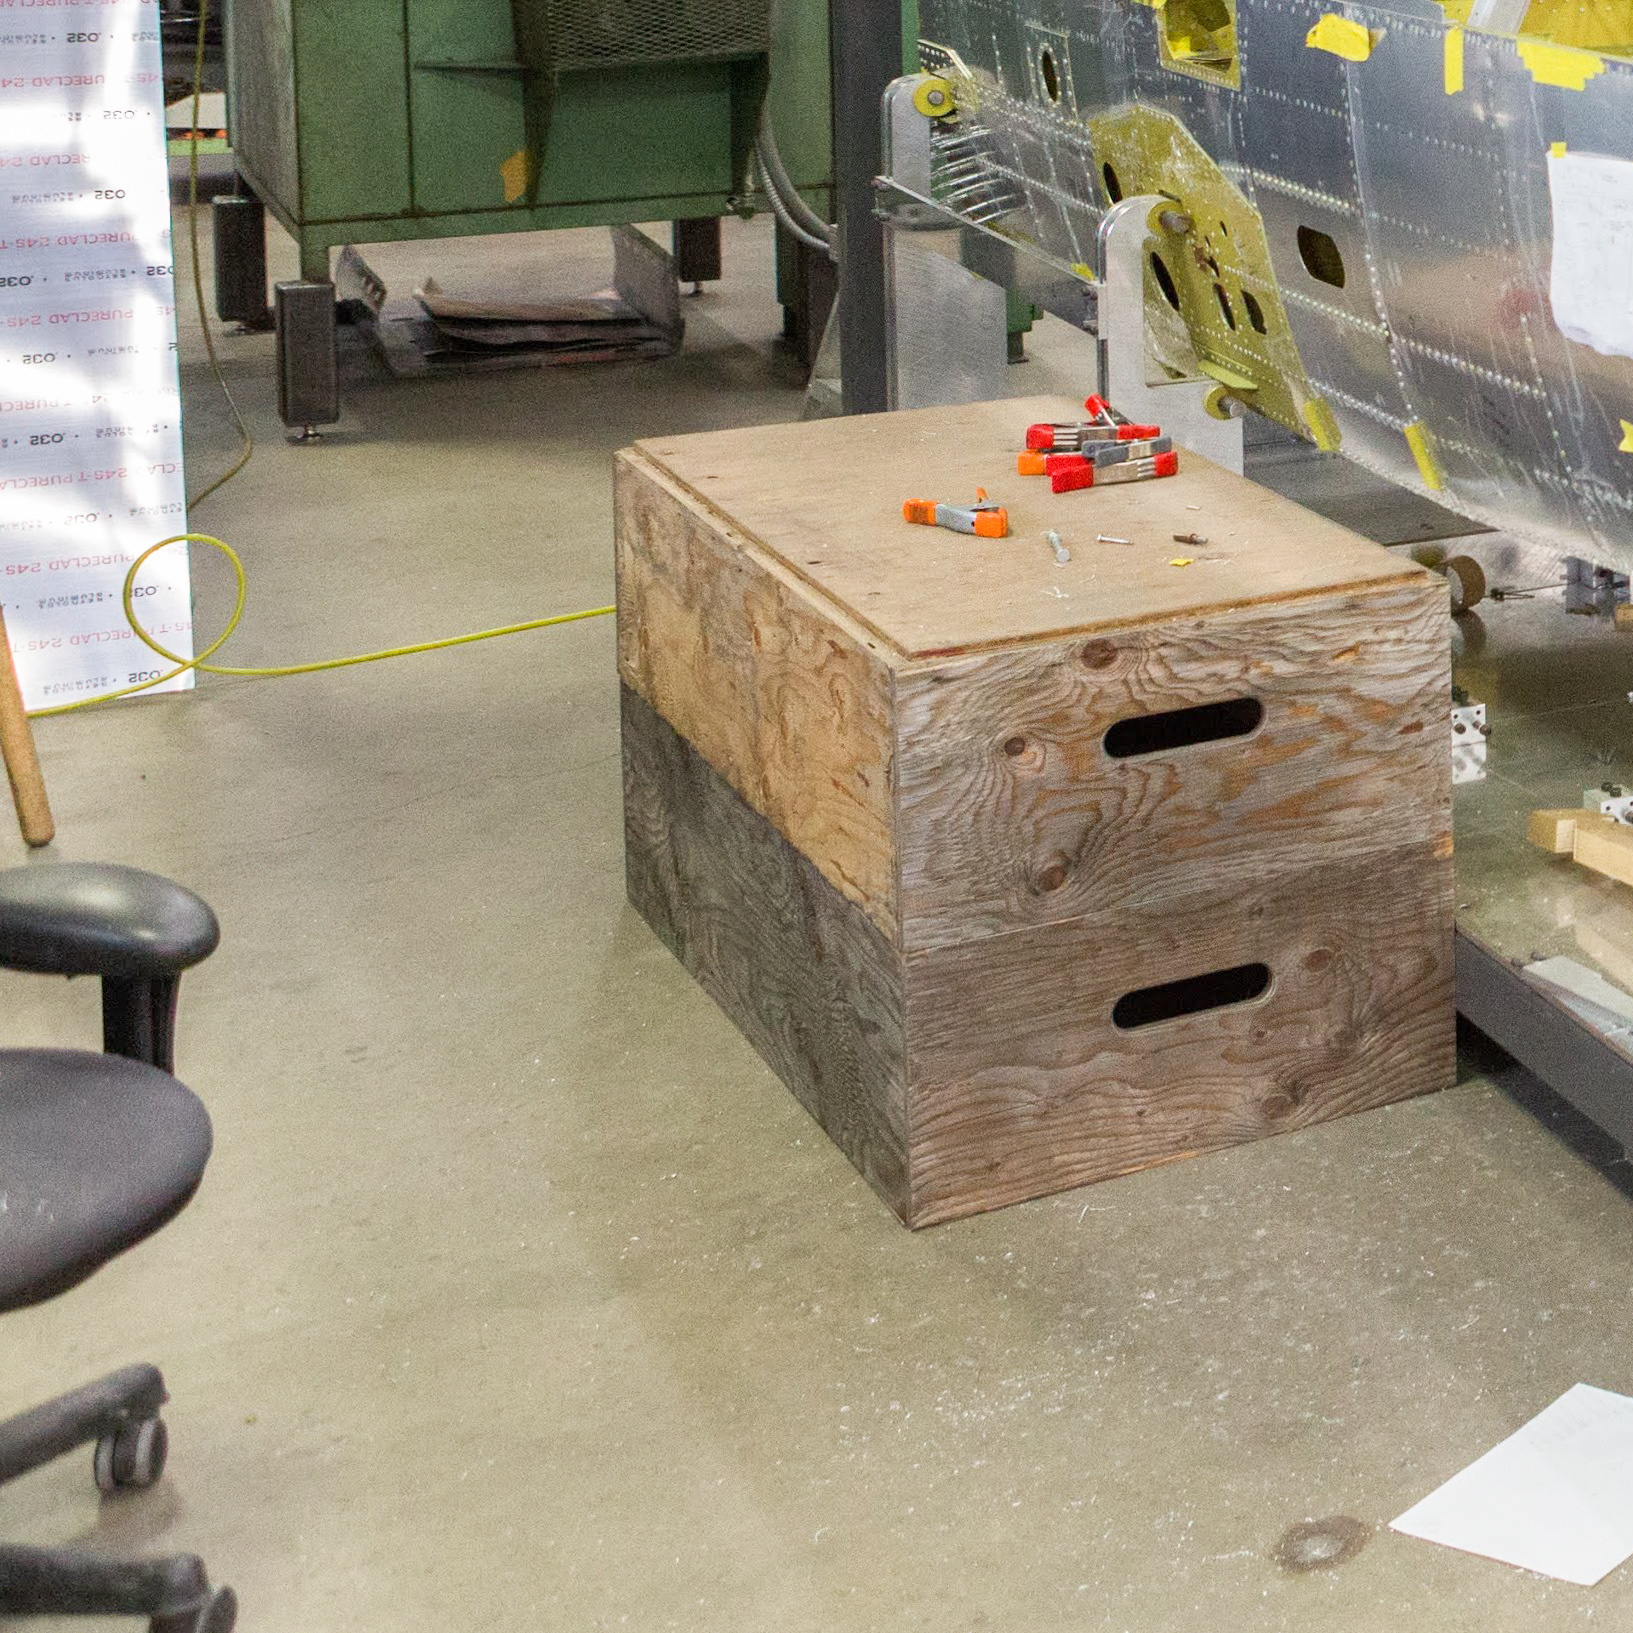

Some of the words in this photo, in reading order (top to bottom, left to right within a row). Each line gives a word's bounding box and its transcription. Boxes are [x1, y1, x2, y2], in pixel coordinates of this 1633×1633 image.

[67, 32, 101, 43] .032
[32, 74, 105, 88] URECLAD
[48, 309, 133, 324] PURECLAD
[30, 432, 66, 446] .032
